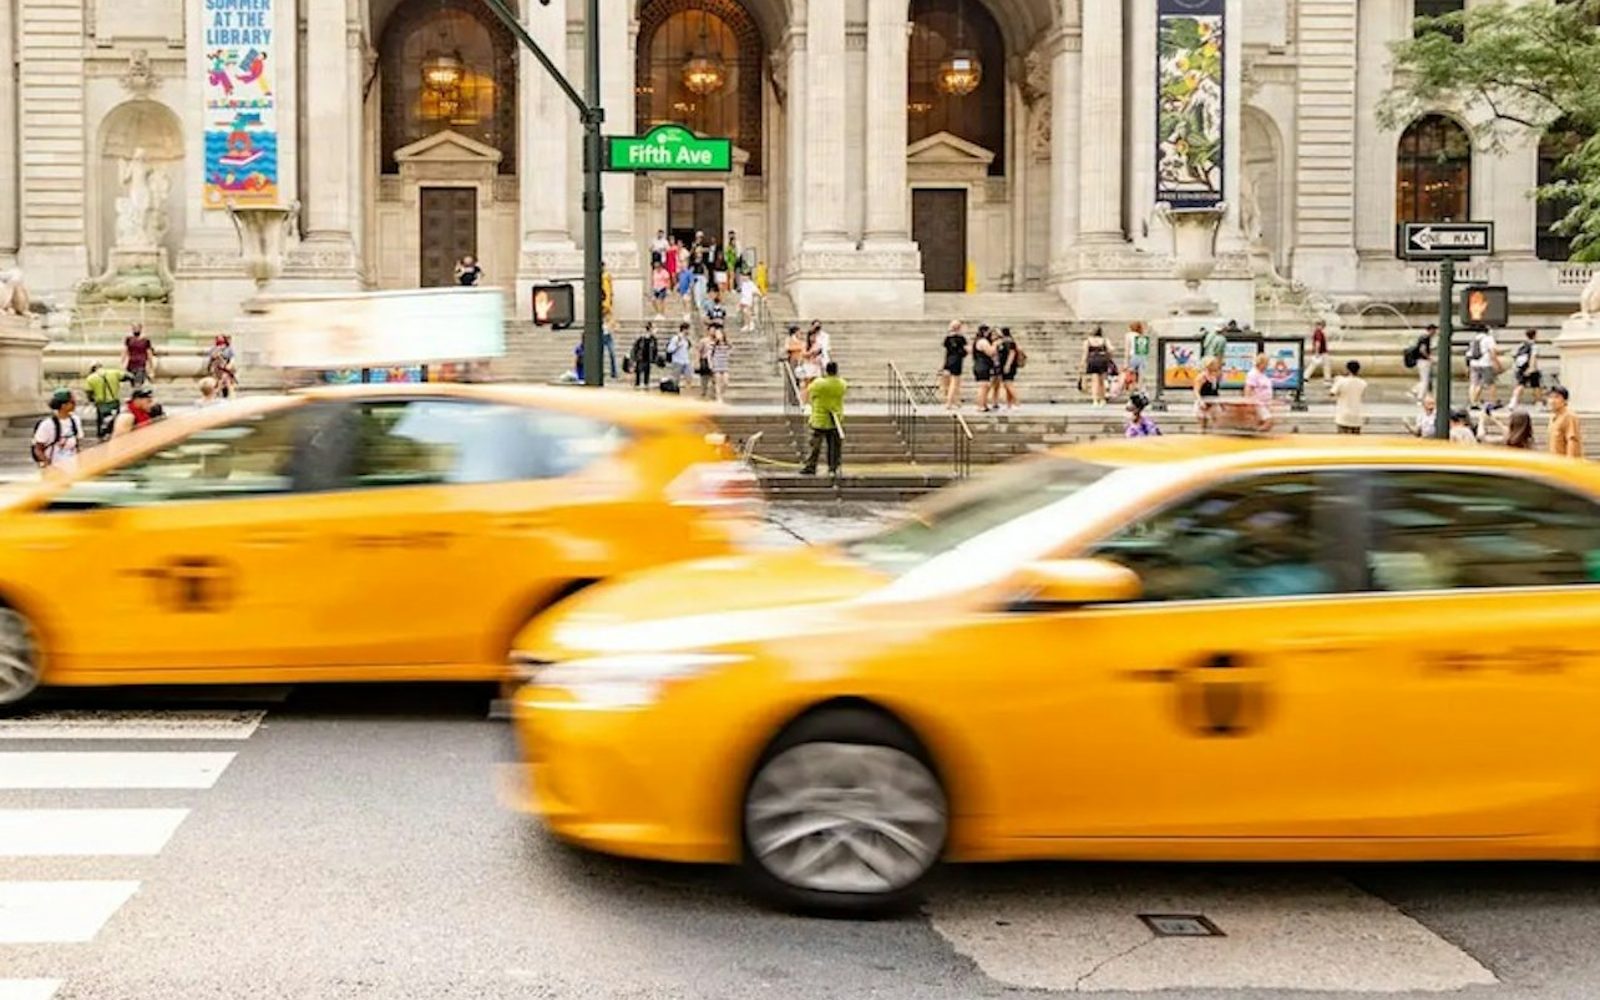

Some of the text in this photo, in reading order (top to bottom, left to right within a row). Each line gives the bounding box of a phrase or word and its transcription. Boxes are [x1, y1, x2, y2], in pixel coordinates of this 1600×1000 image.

[206, 0, 270, 10] SUMMER
[214, 12, 265, 27] AT THE
[207, 29, 271, 45] LIBRARY
[628, 144, 712, 165] Fifth Ave
[1420, 232, 1477, 244] ONE WAY
